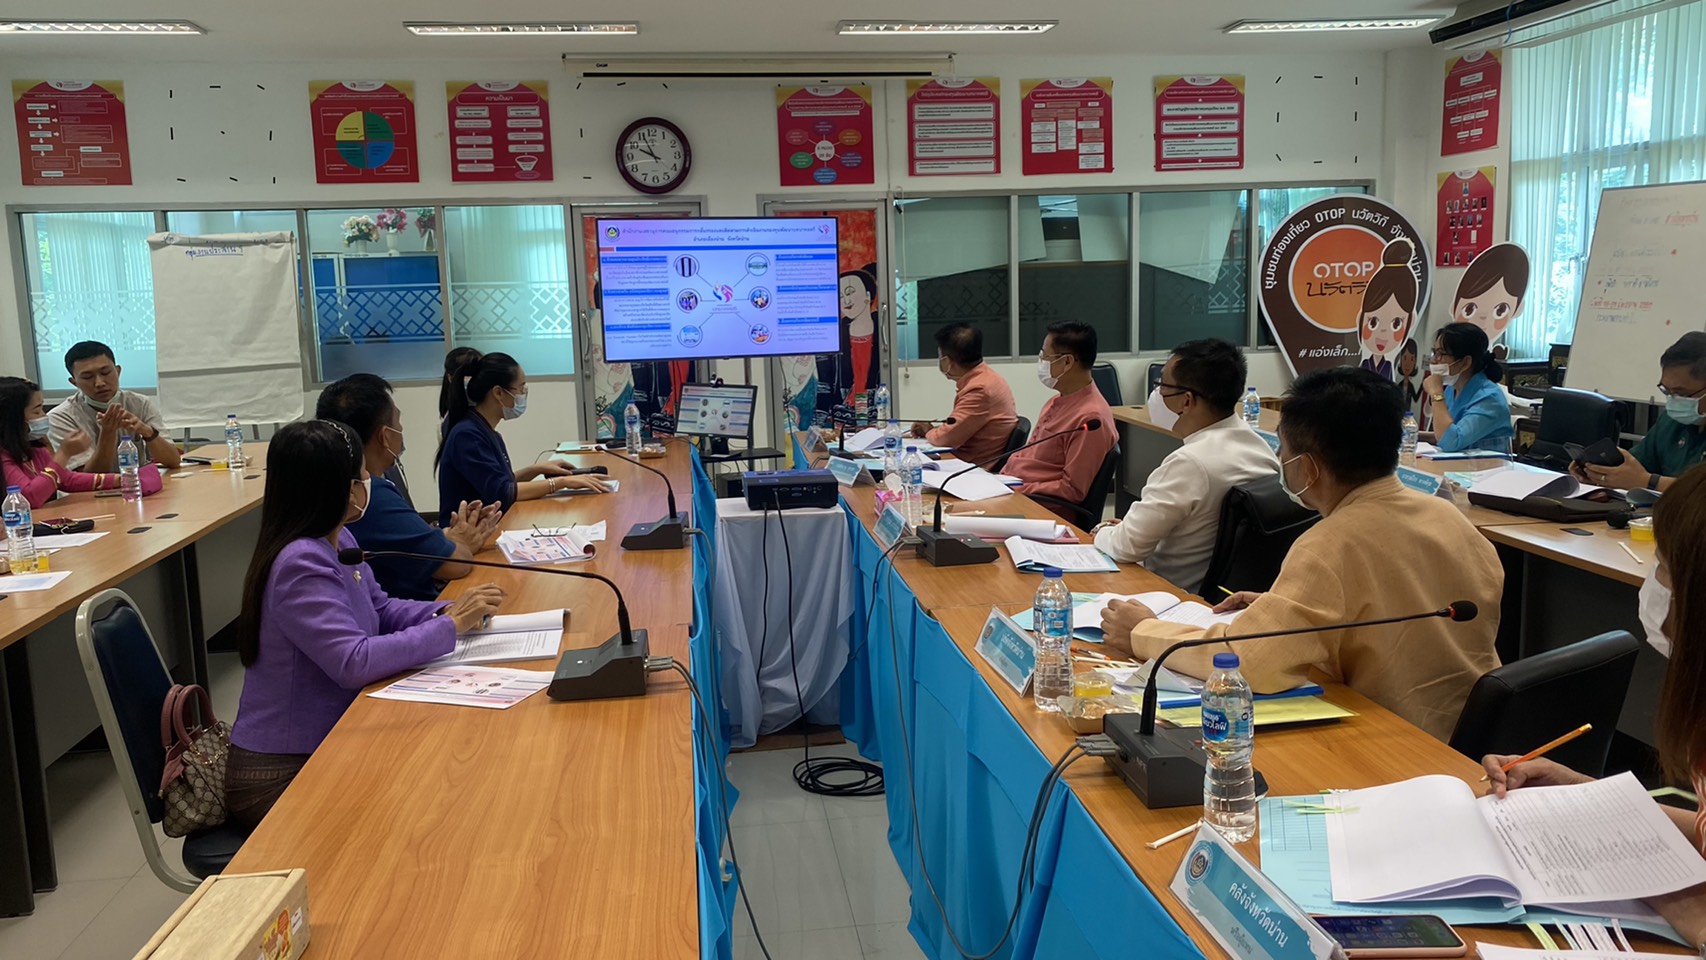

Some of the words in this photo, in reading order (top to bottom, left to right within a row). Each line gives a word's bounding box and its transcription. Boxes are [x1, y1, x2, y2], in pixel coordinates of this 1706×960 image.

[646, 128, 657, 137] 12
[629, 141, 639, 150] 10
[670, 140, 677, 149] 2
[626, 152, 634, 161] 9
[673, 151, 681, 160] 3
[631, 164, 639, 173] 8
[670, 163, 677, 171] 4
[641, 172, 648, 181] 7
[652, 175, 660, 184] 6
[662, 172, 670, 180] 5
[1264, 219, 1311, 290] ชุมชนท่องเที่ยว
[1314, 207, 1346, 223] OTOP
[1351, 208, 1390, 228] นวัตวิถี
[1313, 261, 1375, 279] OTOP
[1228, 882, 1289, 948] คลังจังหวัดน่าน
